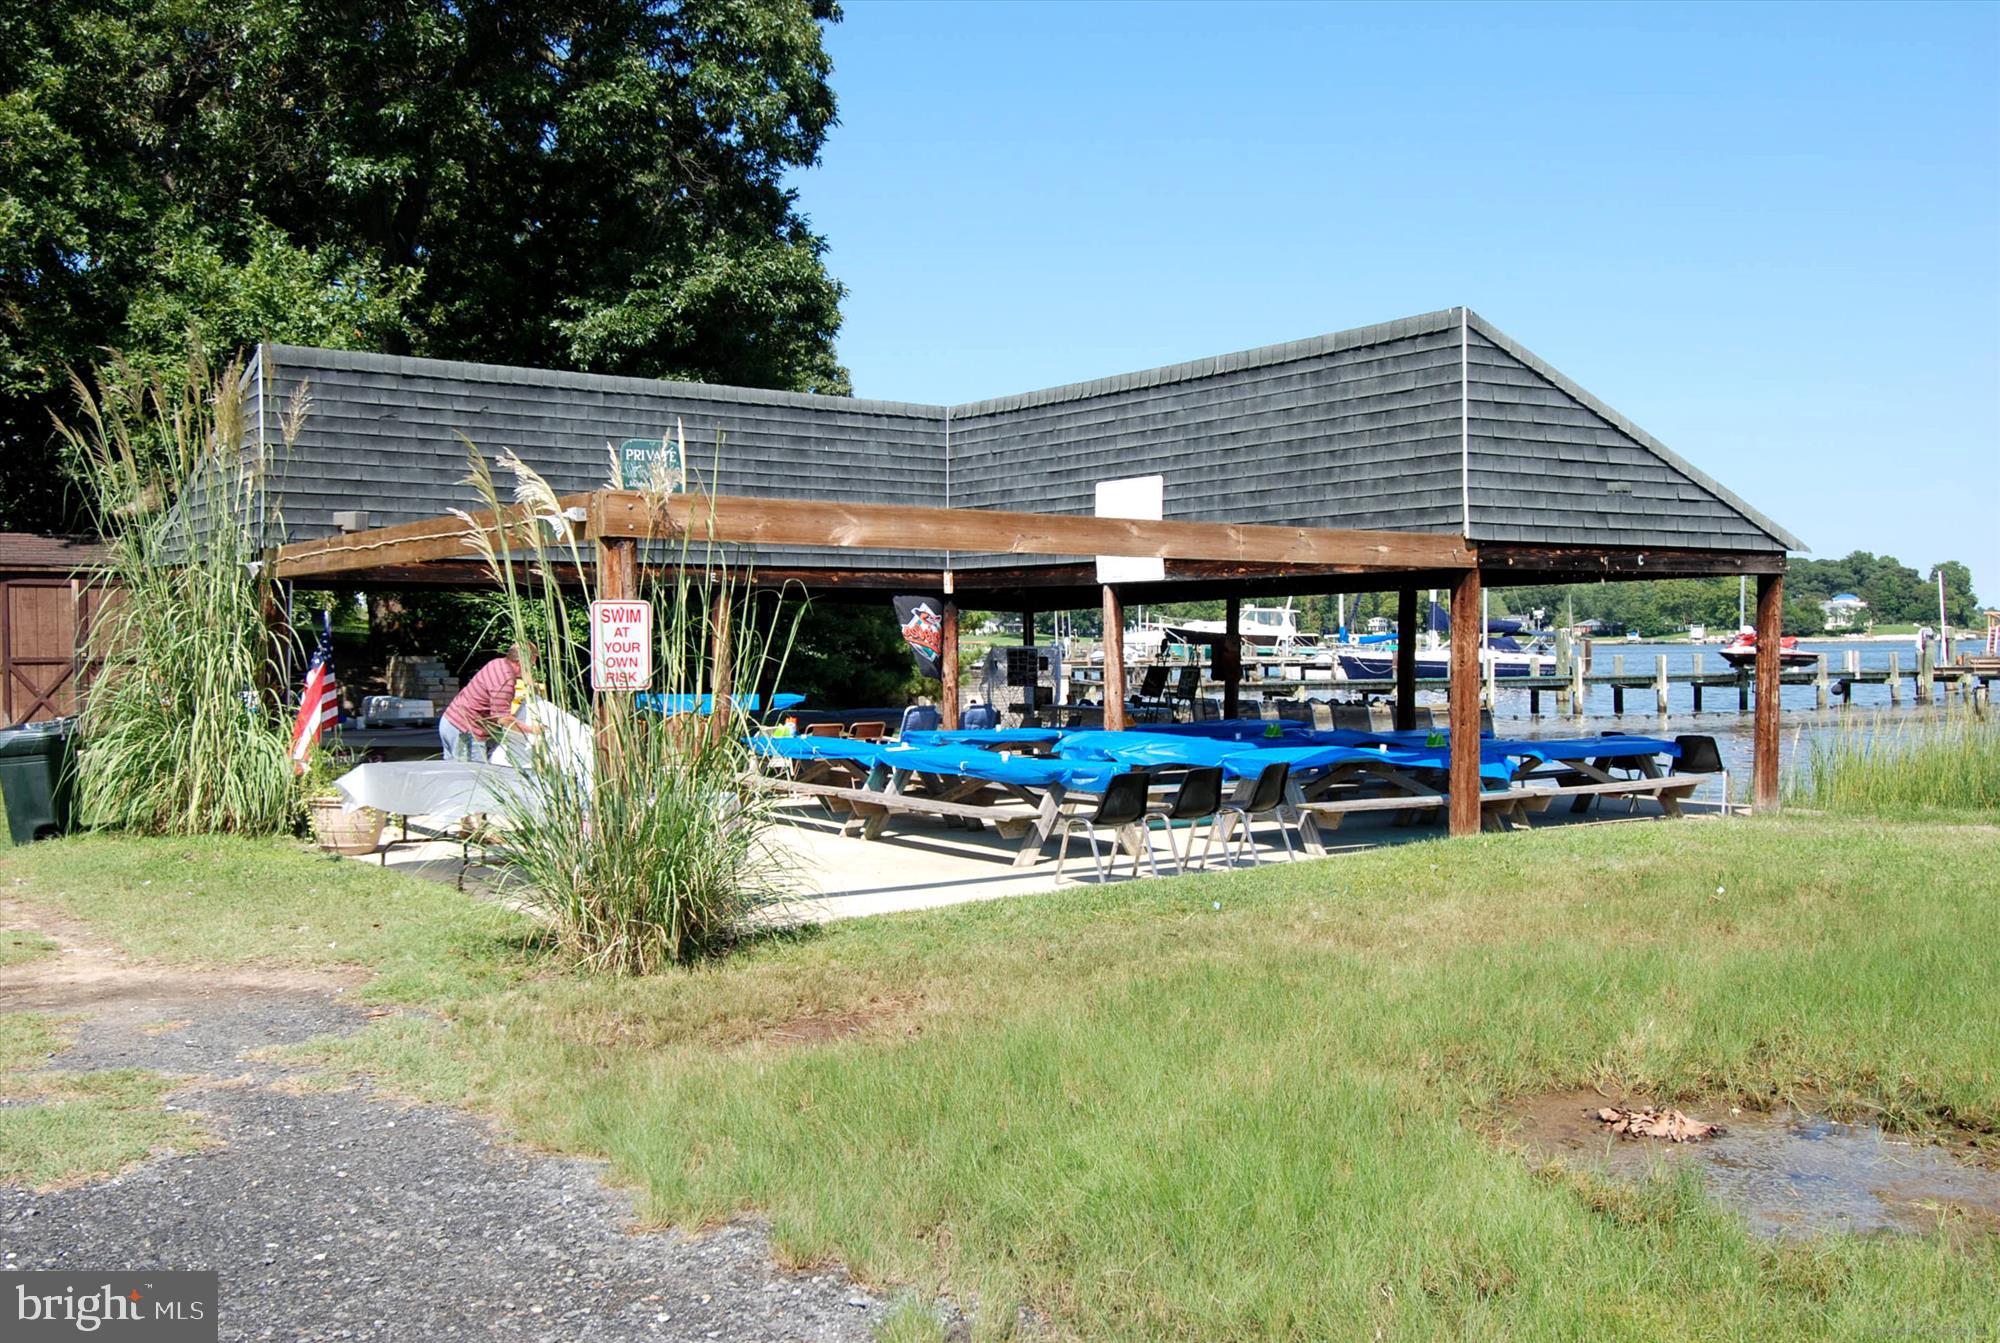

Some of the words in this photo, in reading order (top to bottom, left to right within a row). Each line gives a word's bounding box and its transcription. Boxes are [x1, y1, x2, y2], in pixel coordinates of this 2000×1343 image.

[625, 448, 677, 463] PRIVATE
[601, 608, 641, 624] SWIM
[614, 627, 630, 638] AT
[604, 642, 641, 653] YOUR
[605, 656, 638, 668] OWN
[605, 671, 638, 683] RISK
